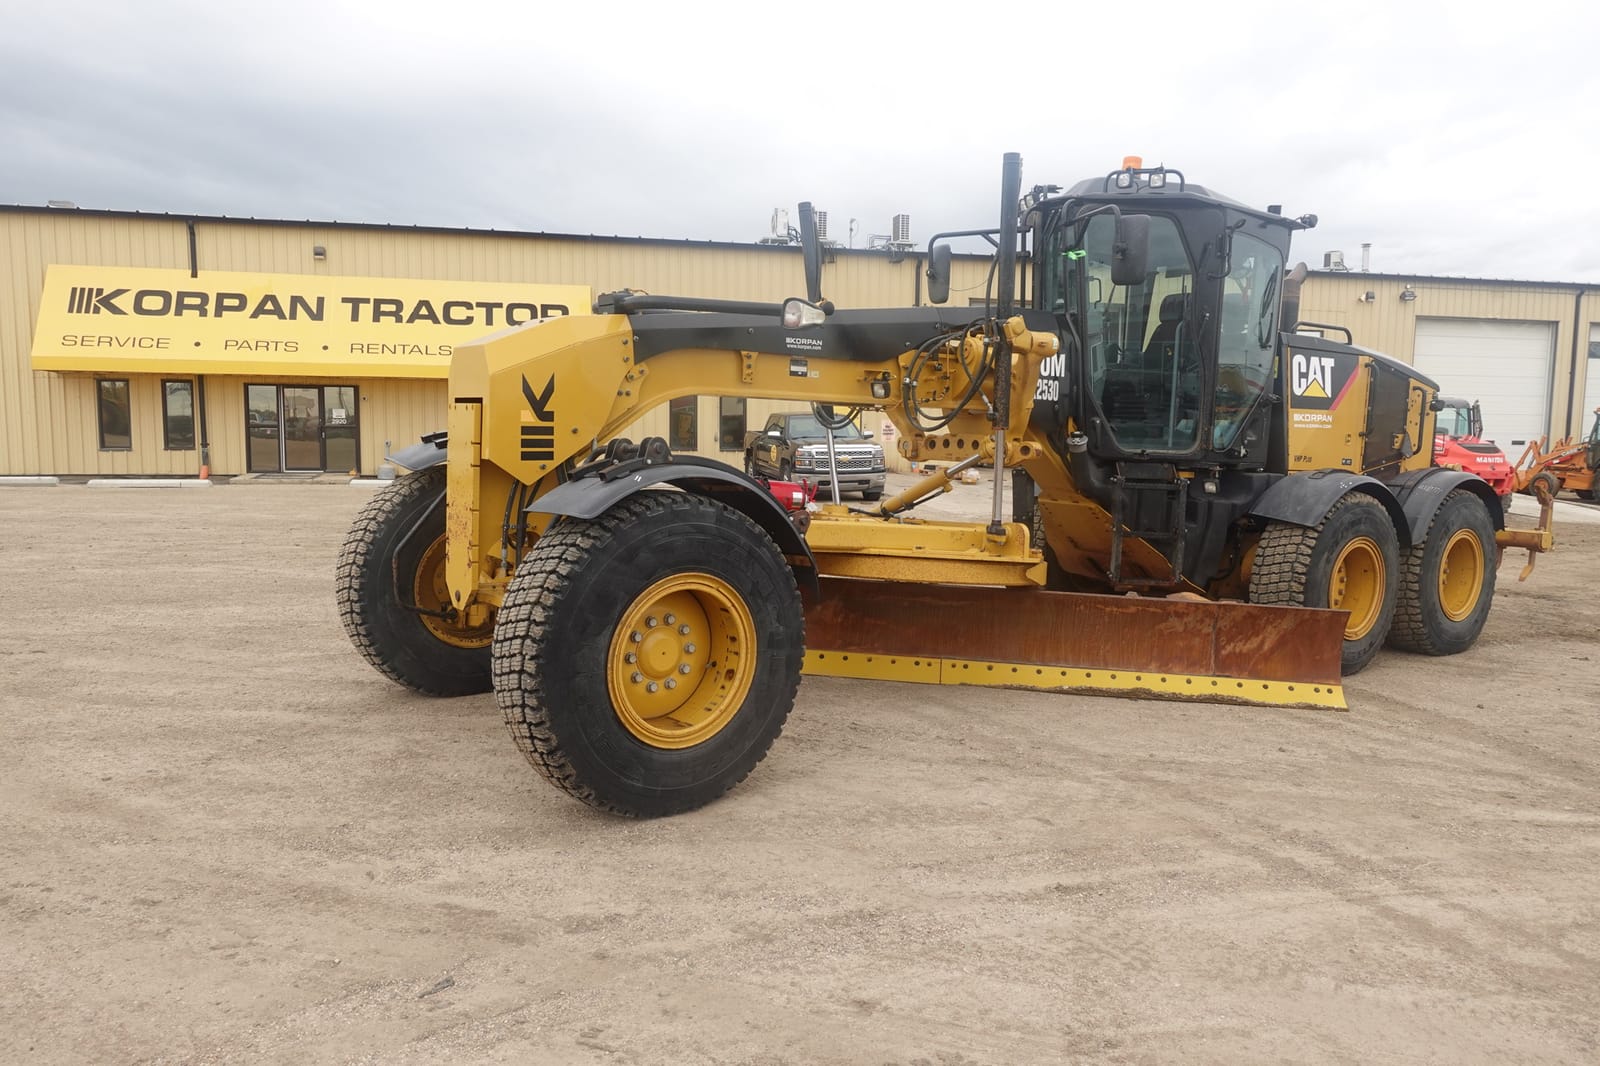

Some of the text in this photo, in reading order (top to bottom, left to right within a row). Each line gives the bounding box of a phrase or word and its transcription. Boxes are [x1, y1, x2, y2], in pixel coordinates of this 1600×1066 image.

[67, 286, 325, 322] KORPAN
[61, 334, 453, 357] SERVICE PARTS RENTALS
[785, 337, 823, 346] KORPAN
[1292, 354, 1335, 398] CAT
[1033, 379, 1060, 402] 2530
[1293, 413, 1333, 422] KORPAN
